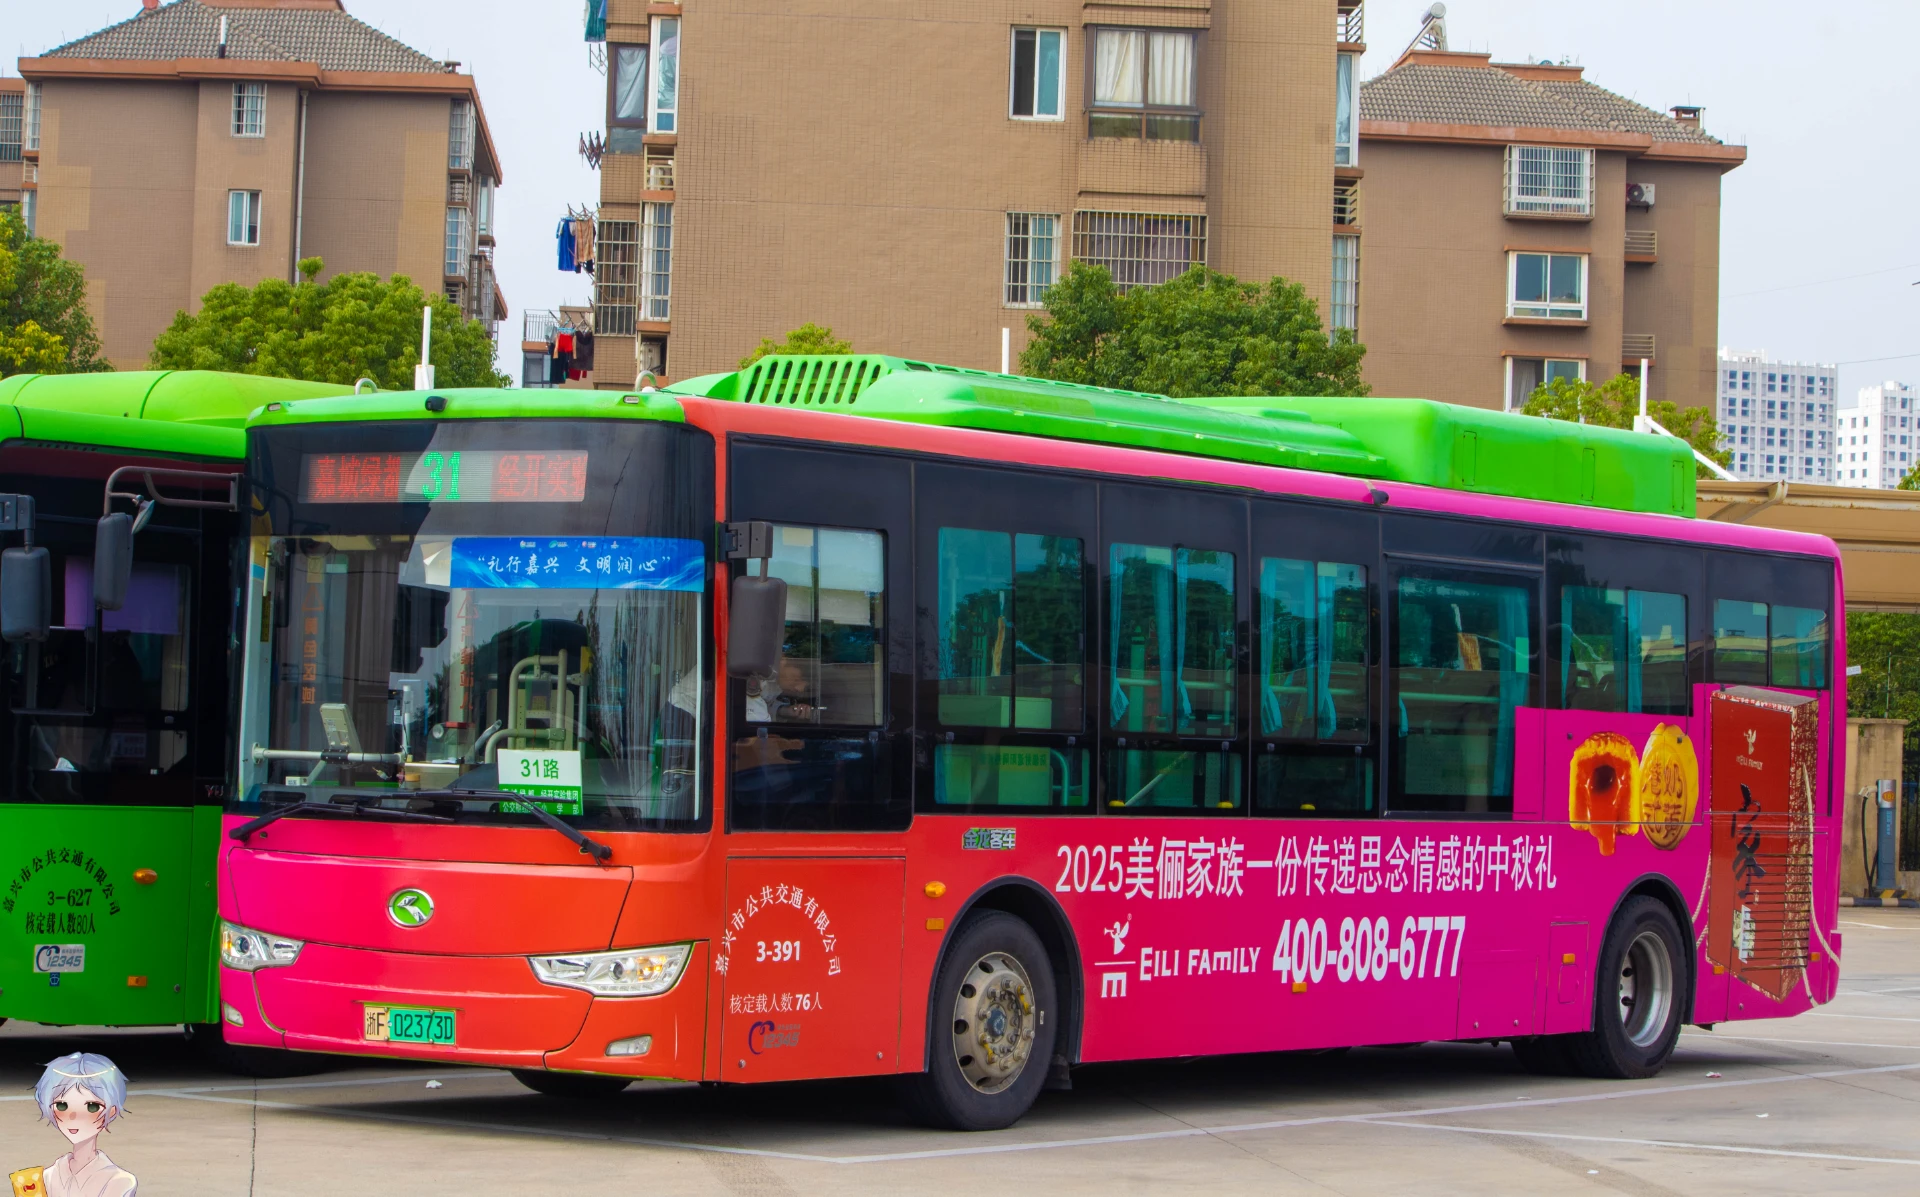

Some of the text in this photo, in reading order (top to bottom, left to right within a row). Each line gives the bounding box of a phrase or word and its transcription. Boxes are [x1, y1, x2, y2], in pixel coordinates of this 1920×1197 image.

[422, 452, 461, 500] 31
[520, 758, 559, 779] 31路
[2, 847, 121, 916] 嘉兴市公共交通有限公司
[1056, 834, 1557, 900] 2025美俪家族一份传递思念情感的中秋礼
[47, 888, 93, 907] 3-627
[714, 883, 841, 977] 嘉兴市公共交通有限公司
[756, 941, 801, 962] 3-391
[1273, 915, 1466, 984] 400-808-6777
[46, 955, 82, 967] 12345
